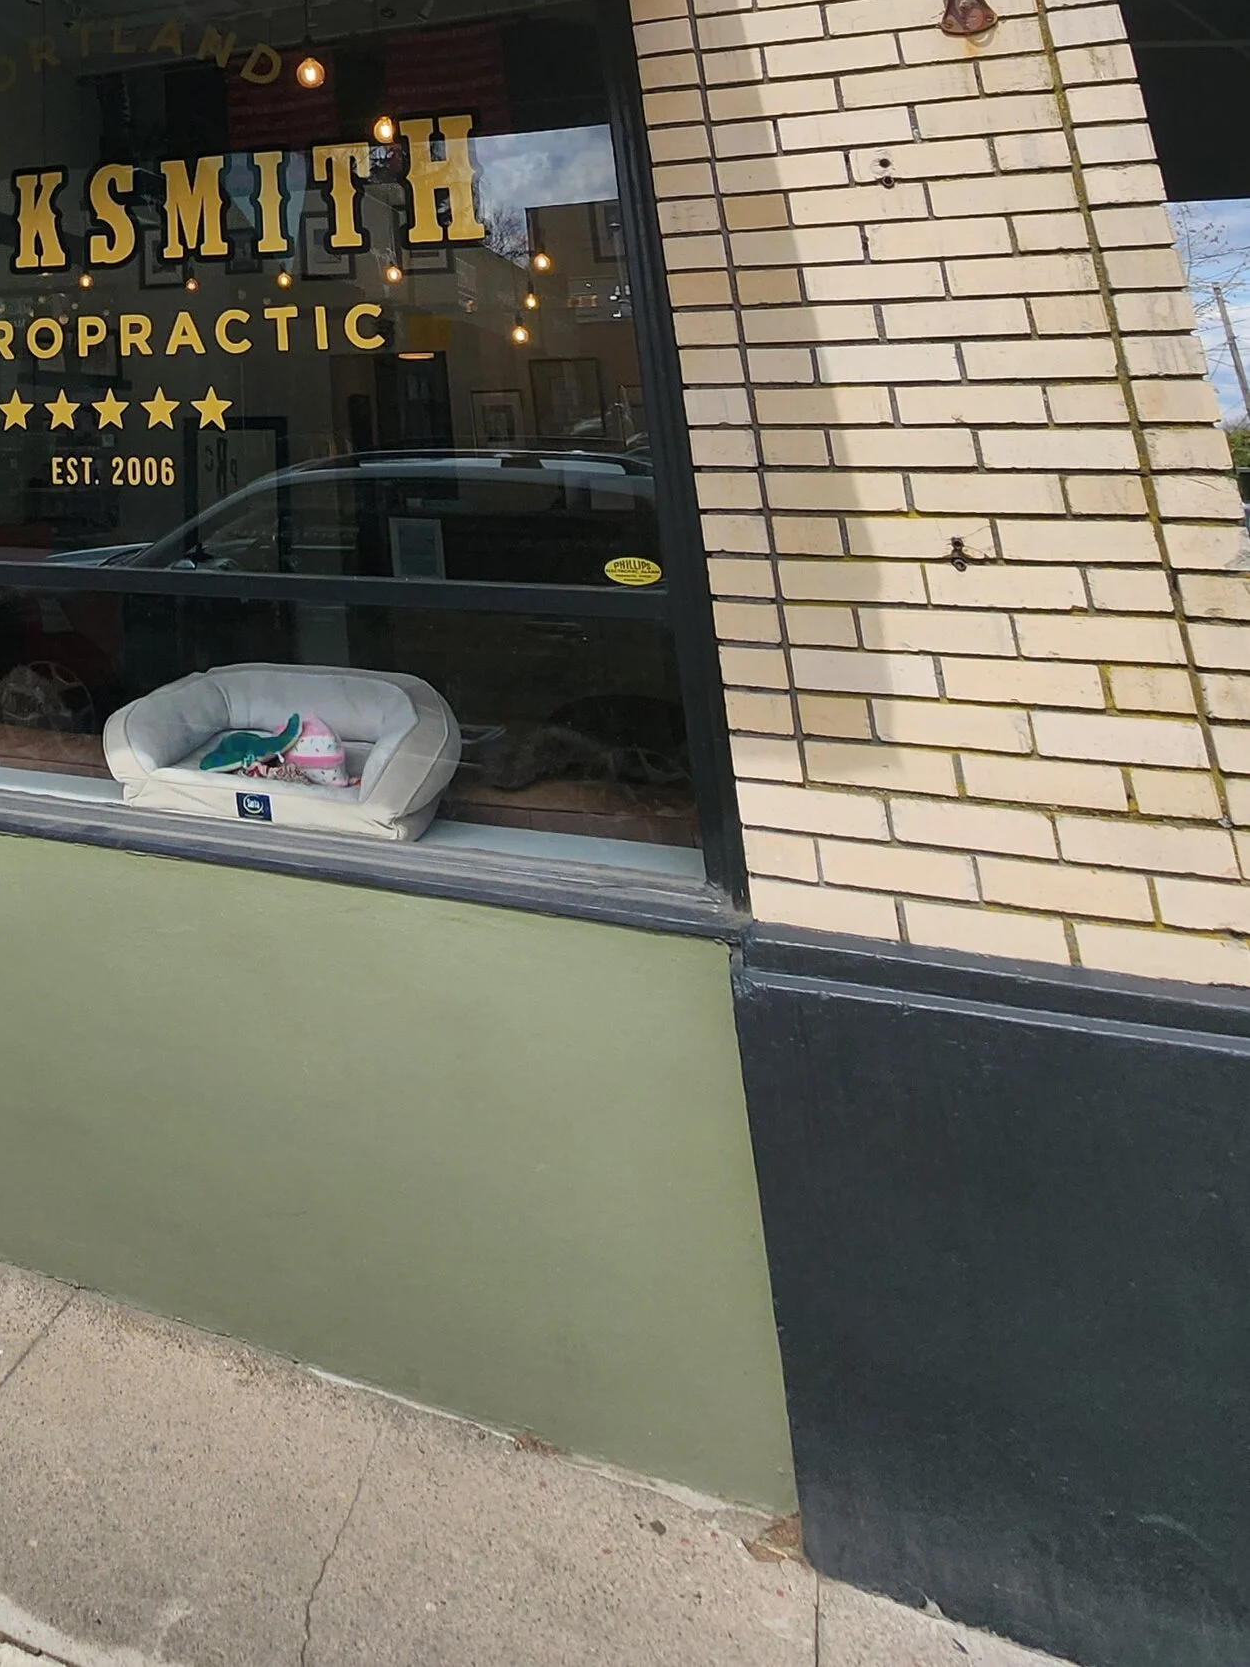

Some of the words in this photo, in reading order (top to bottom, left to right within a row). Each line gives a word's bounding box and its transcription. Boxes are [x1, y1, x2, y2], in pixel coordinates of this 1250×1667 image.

[50, 455, 100, 487] EST.
[111, 454, 176, 487] 2006
[613, 559, 652, 570] PHILLIPS
